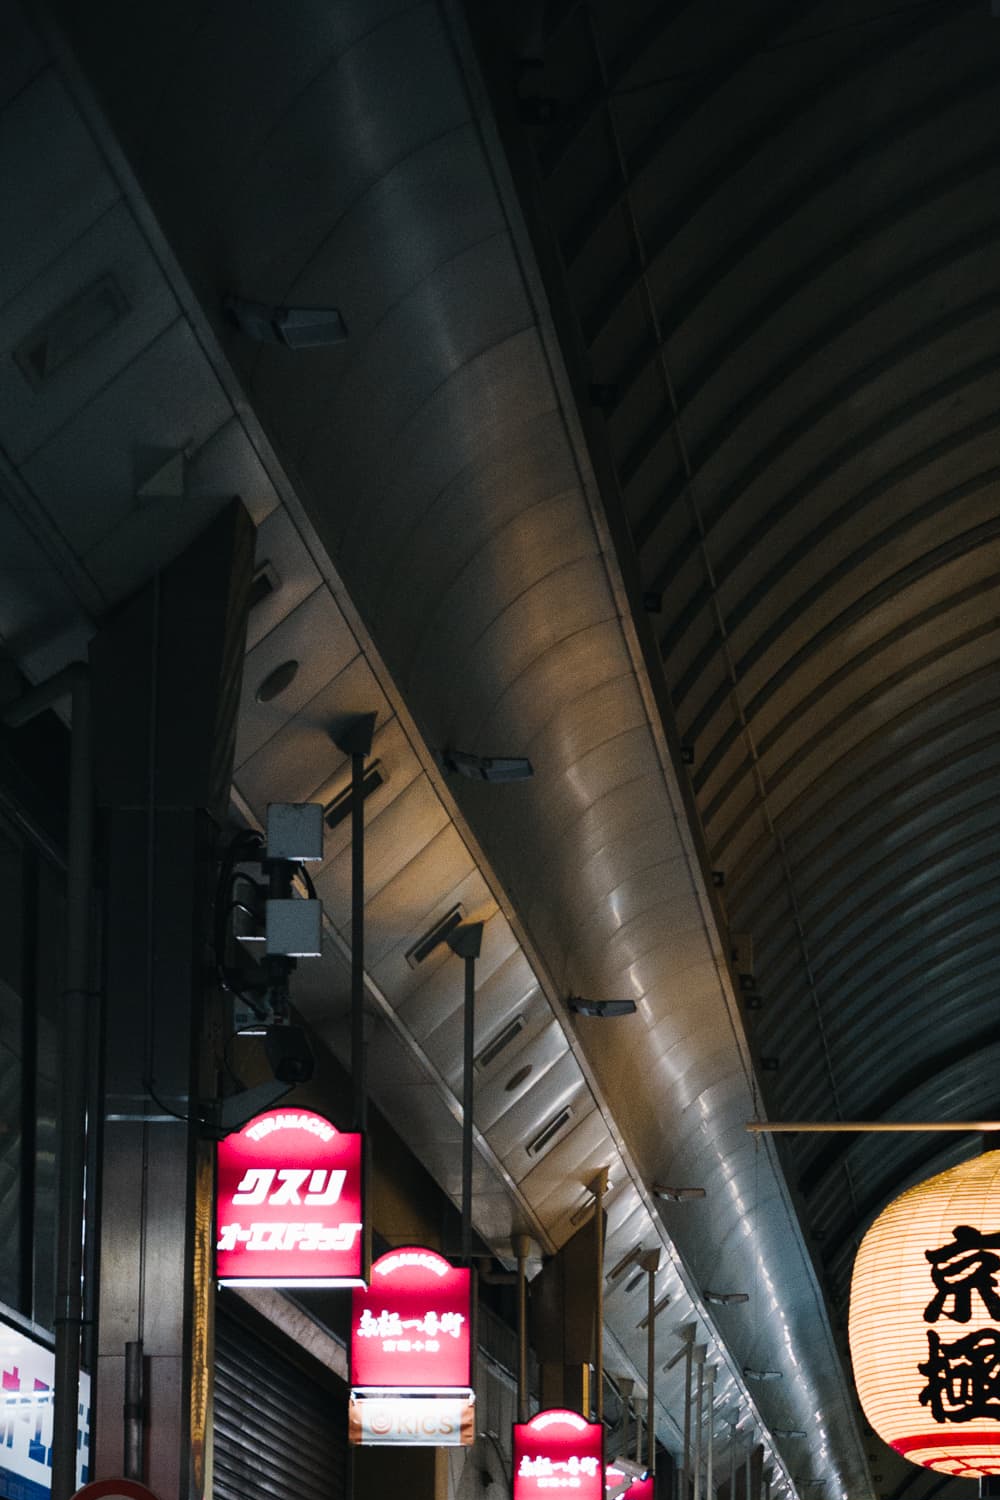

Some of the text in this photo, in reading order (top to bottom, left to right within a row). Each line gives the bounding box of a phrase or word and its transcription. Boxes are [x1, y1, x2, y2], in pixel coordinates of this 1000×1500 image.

[232, 1168, 348, 1206] クスリ
[397, 1416, 454, 1435] KICS
